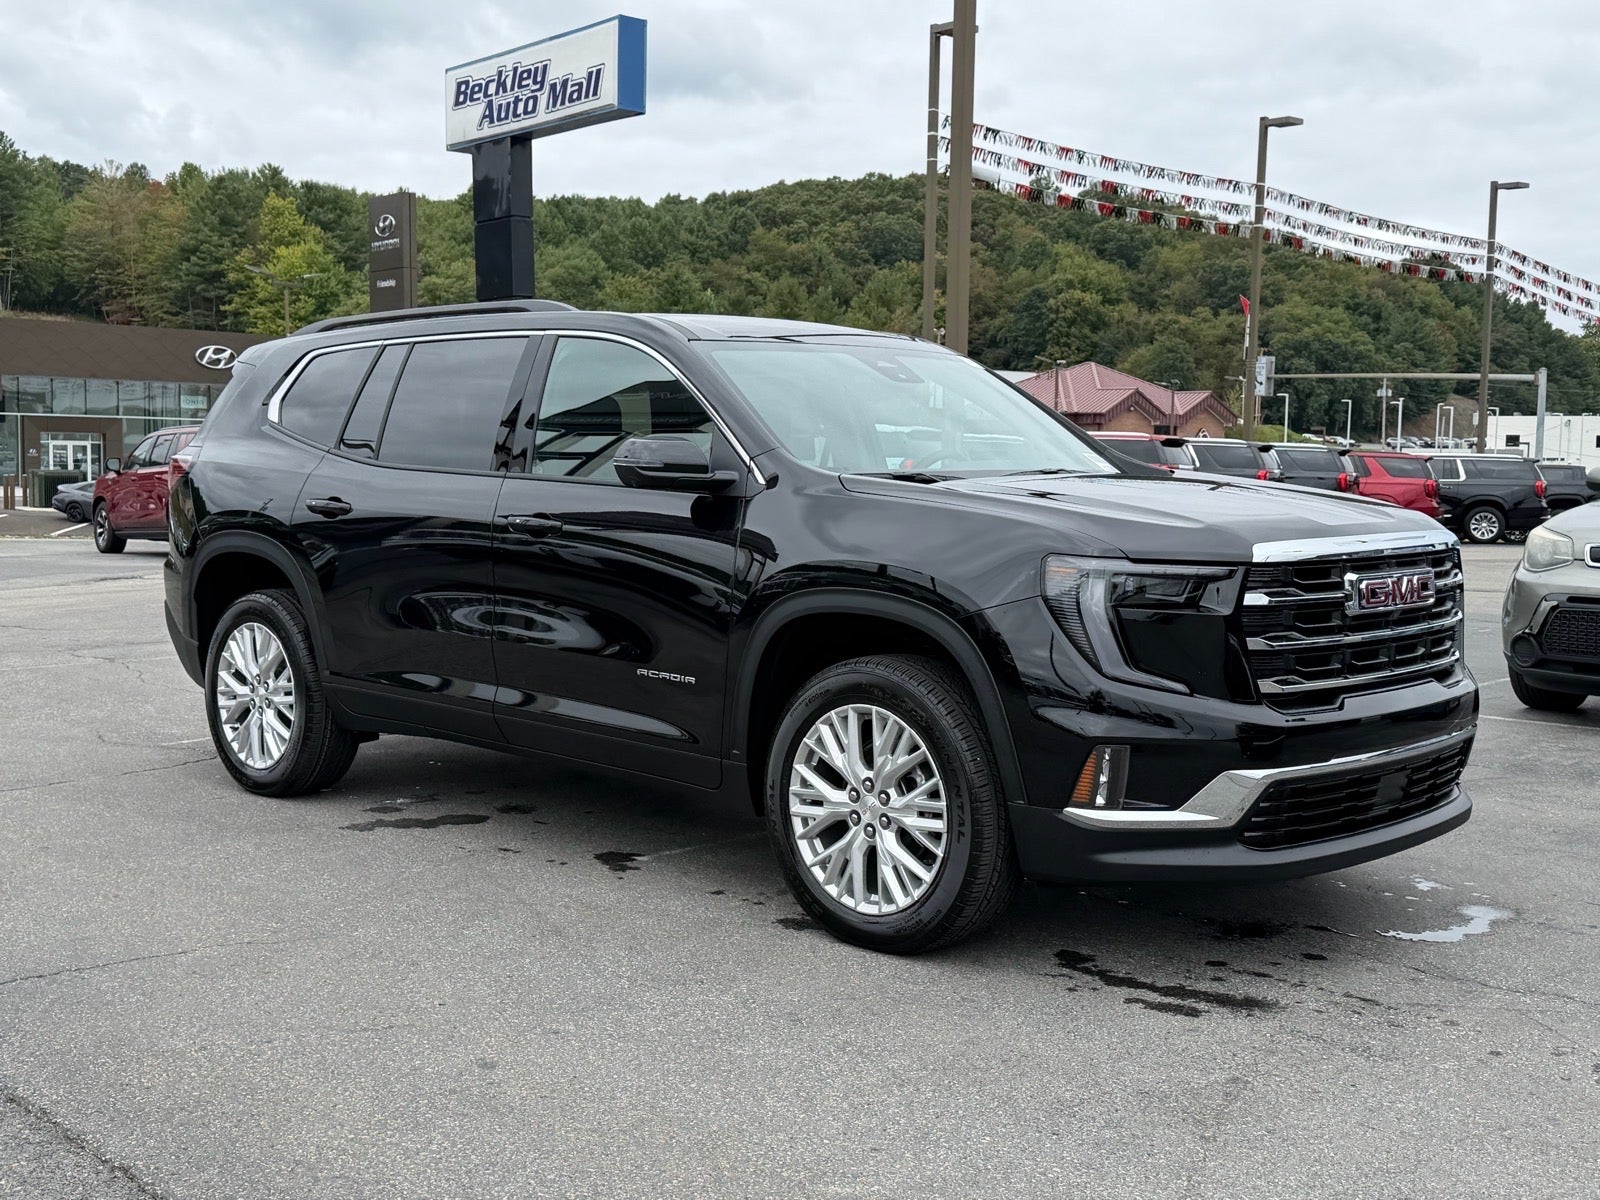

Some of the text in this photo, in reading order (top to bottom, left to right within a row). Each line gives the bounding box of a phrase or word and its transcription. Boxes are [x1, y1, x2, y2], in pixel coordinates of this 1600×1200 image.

[453, 60, 550, 109] Beckley
[478, 65, 604, 129] Auto Mall
[1361, 574, 1434, 608] GMC
[636, 668, 696, 684] ACADIA
